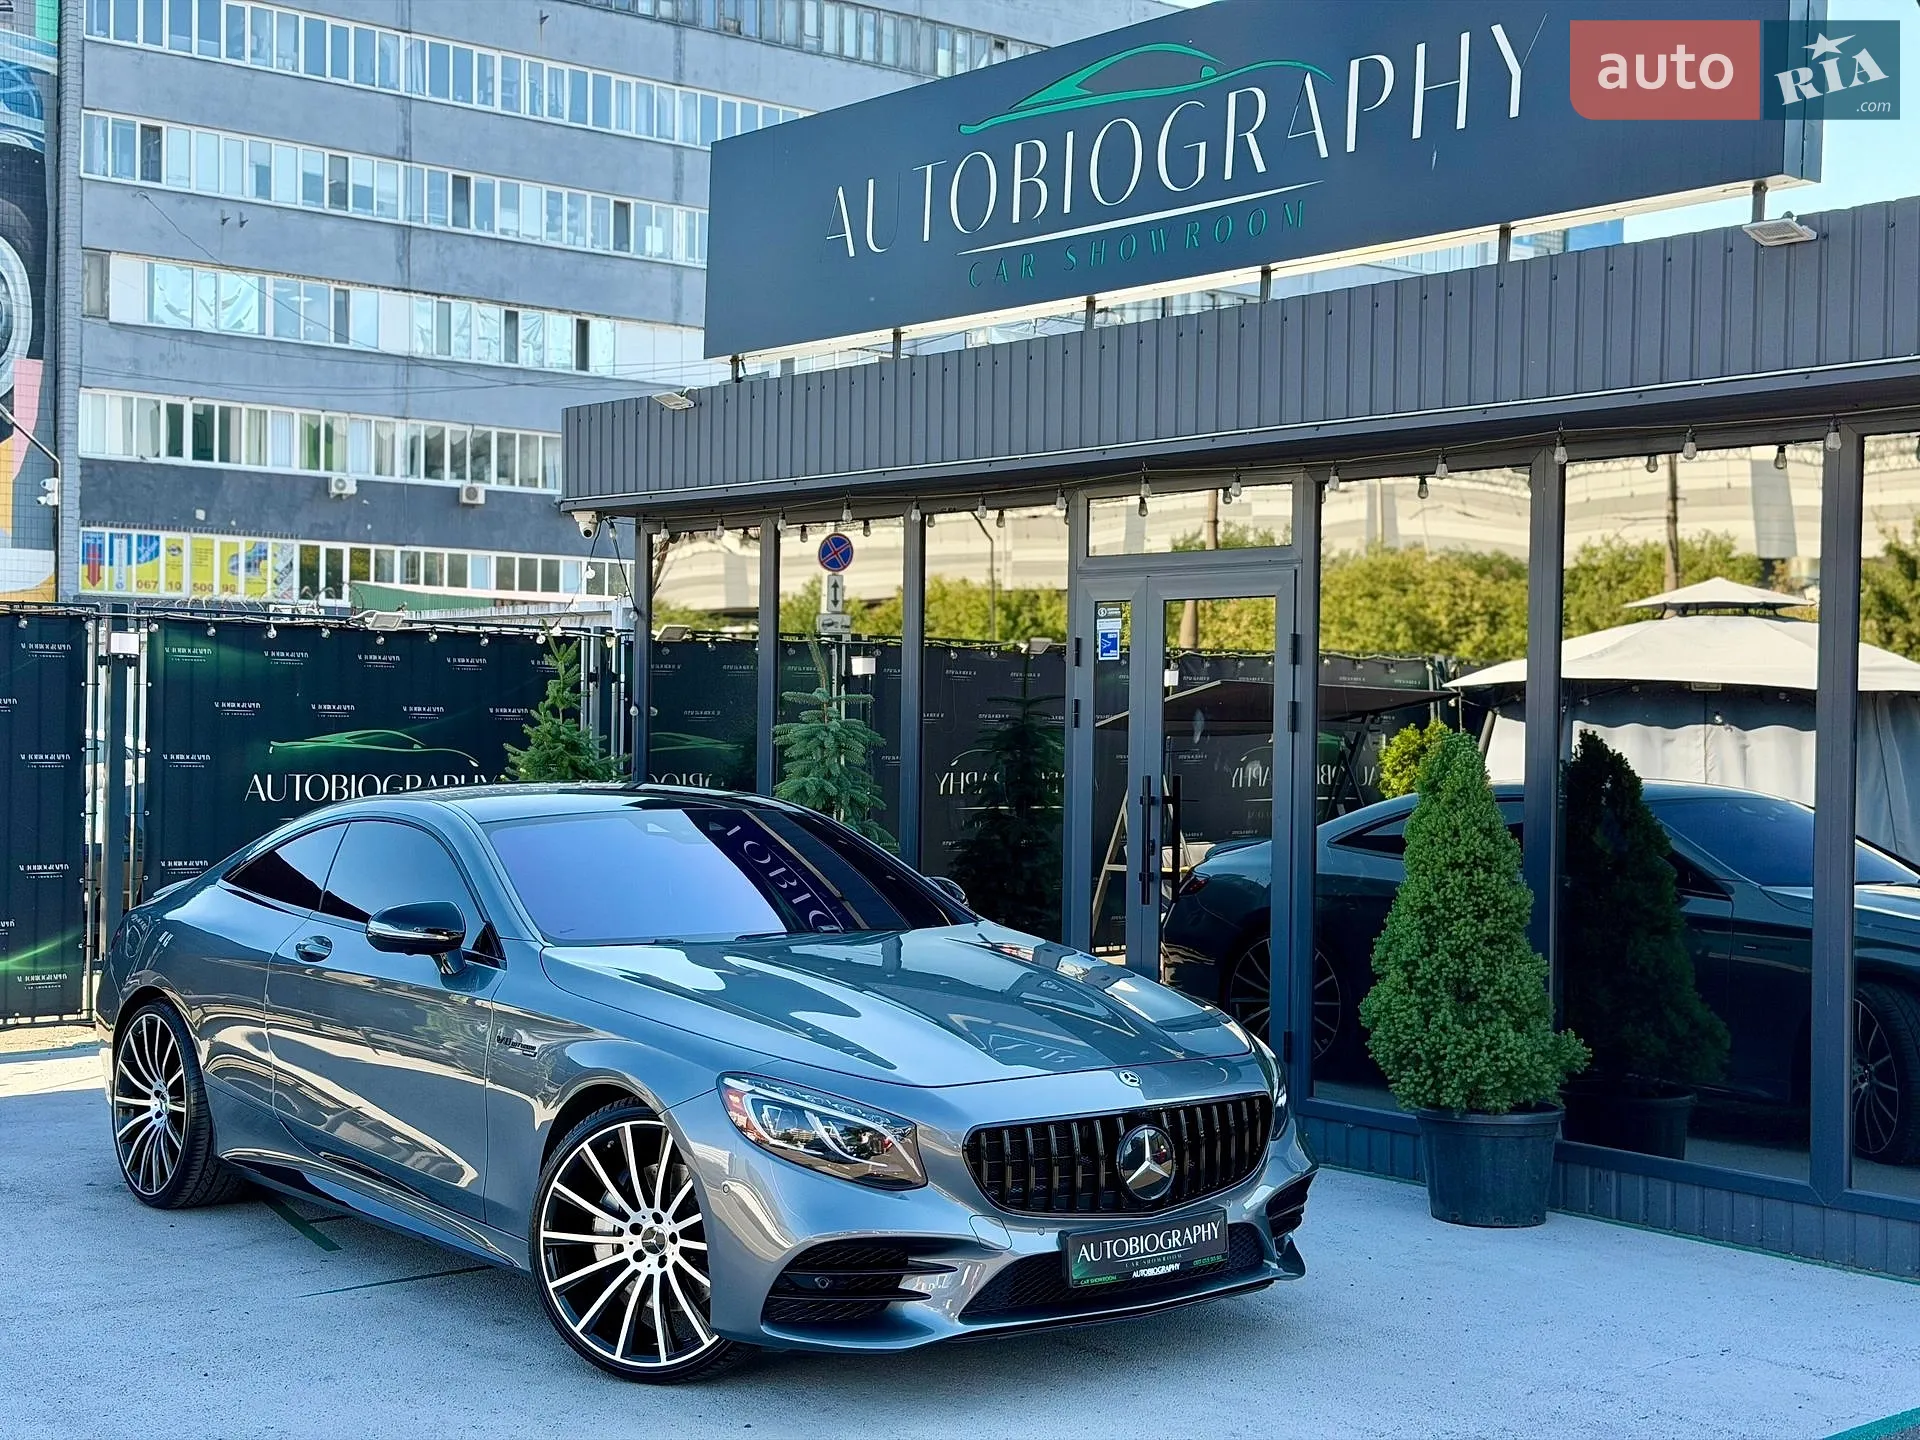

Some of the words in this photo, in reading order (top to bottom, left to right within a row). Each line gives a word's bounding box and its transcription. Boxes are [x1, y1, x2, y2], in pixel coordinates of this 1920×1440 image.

[821, 13, 1548, 259] AUTOBIOGRAPHY
[968, 252, 1036, 288] CAR
[1063, 199, 1305, 272] SHOWROOM
[136, 579, 159, 590] 067
[1077, 1220, 1221, 1263] AUTOBIOGRAPHY
[1132, 1263, 1181, 1279] AUTOBIOGRAPHY
